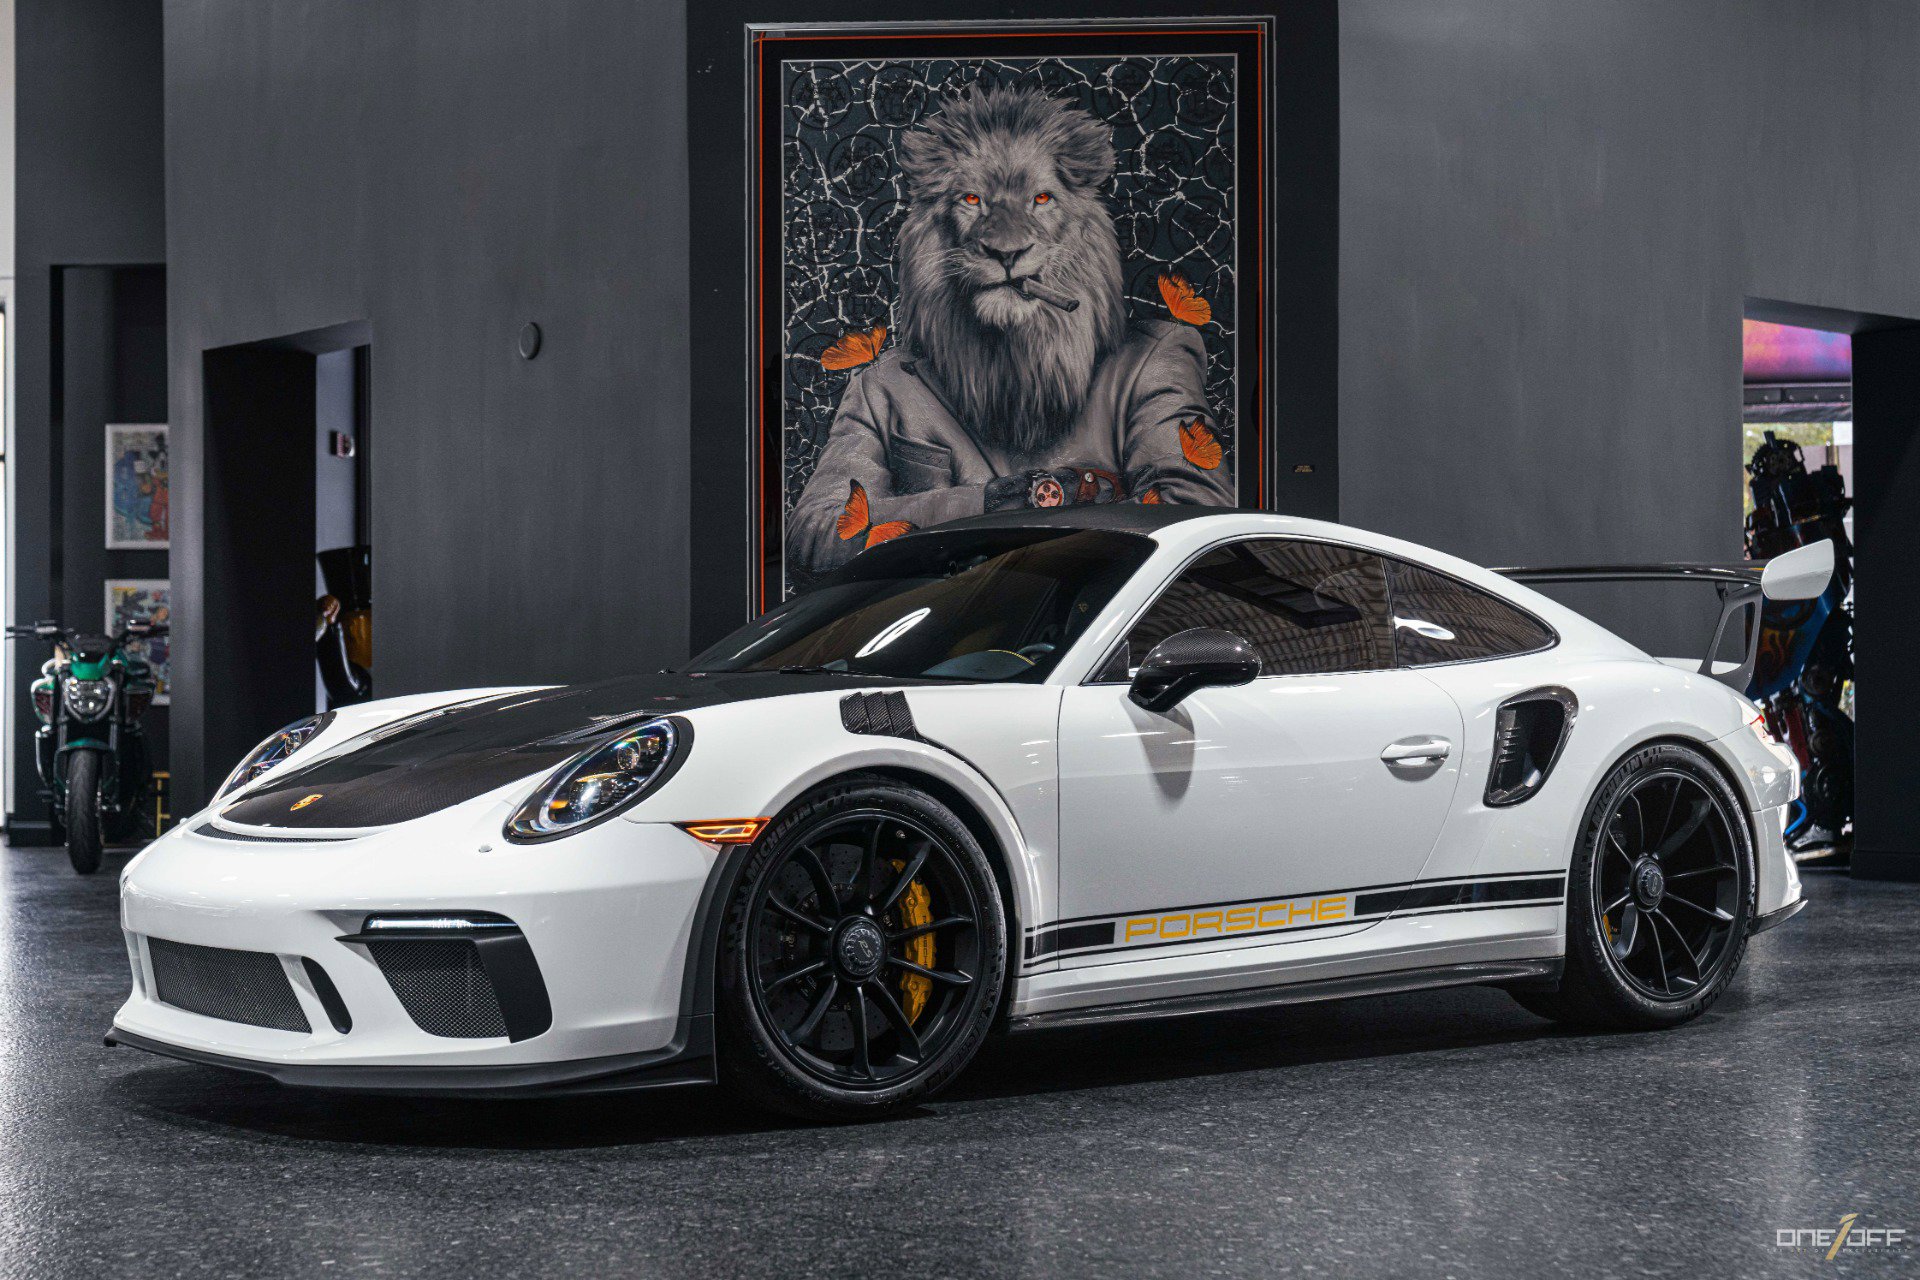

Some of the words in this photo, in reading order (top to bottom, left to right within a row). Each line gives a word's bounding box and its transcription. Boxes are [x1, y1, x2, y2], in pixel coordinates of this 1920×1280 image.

[1592, 754, 1642, 830] MICHELIN
[745, 802, 814, 881] MICHELIN
[1125, 896, 1348, 942] PORSCHE
